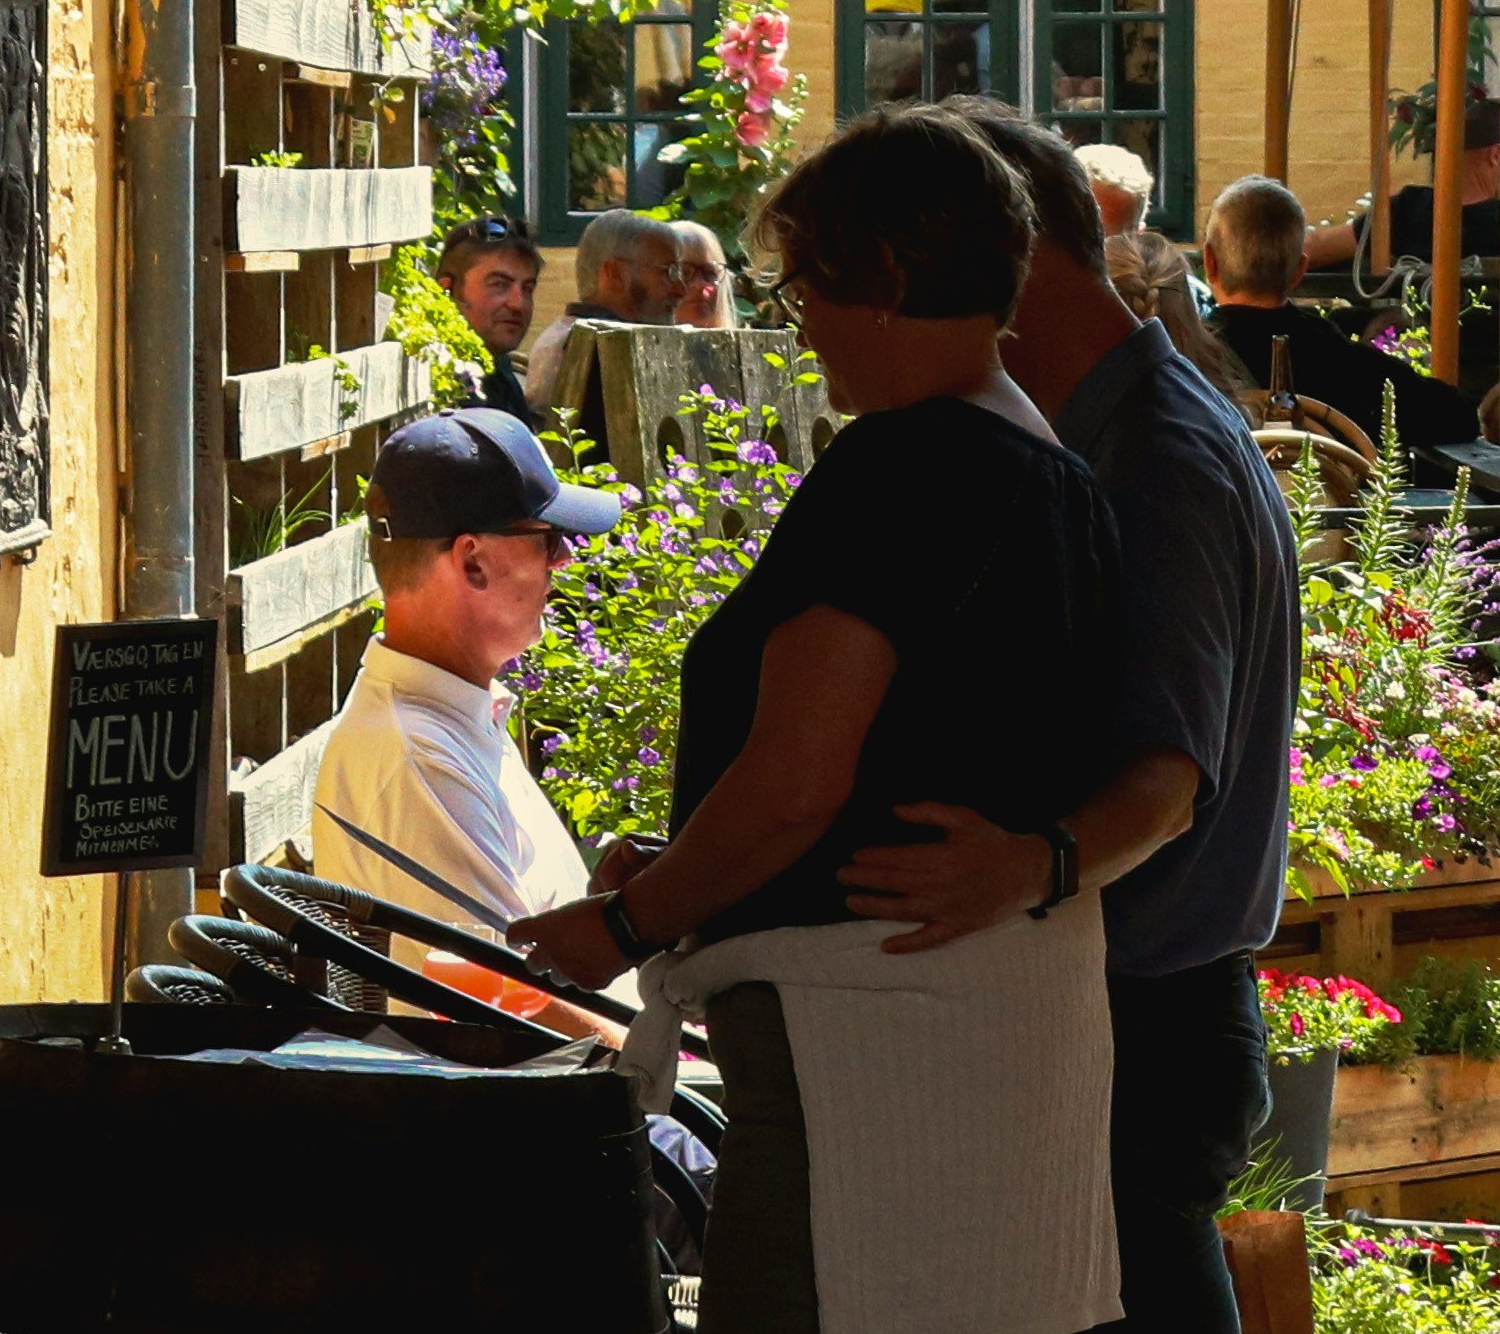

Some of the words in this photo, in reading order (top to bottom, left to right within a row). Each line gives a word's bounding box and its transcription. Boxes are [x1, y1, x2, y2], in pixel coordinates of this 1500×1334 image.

[152, 644, 179, 665] TAG
[182, 640, 204, 660] EN
[69, 676, 131, 708] PLEASE
[134, 677, 177, 698] TAKE
[182, 675, 194, 695] A
[66, 709, 199, 789] MENU
[75, 793, 125, 822] BITTE
[129, 794, 169, 815] EINE
